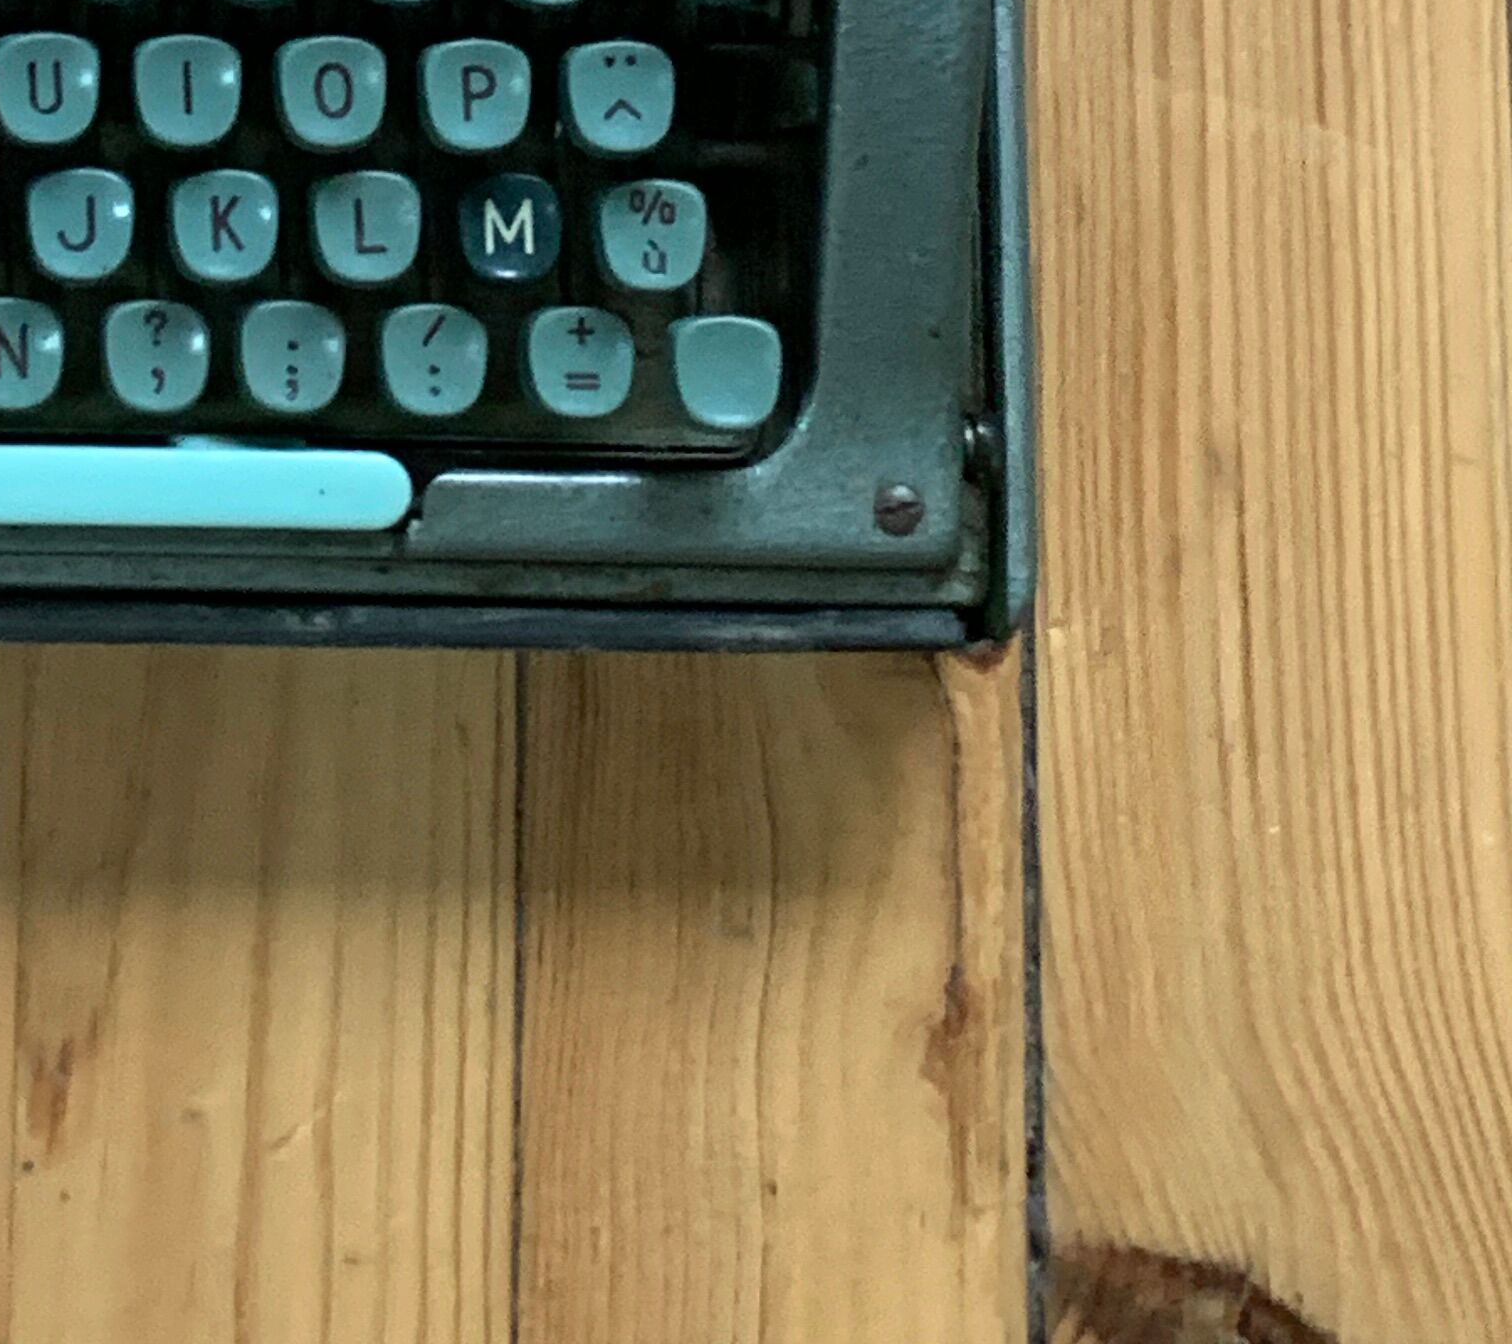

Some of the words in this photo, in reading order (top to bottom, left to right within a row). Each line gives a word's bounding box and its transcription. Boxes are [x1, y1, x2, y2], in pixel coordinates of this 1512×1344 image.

[26, 60, 63, 114] U
[183, 60, 192, 115] I
[313, 62, 353, 119] O
[461, 64, 497, 122] P
[629, 188, 676, 224] %
[57, 195, 95, 251] J
[210, 195, 245, 252] K
[354, 198, 388, 253] L
[486, 198, 535, 255] M
[642, 241, 667, 275] ù
[143, 309, 167, 345] ?
[422, 315, 446, 346] /
[567, 317, 595, 344] +
[564, 371, 600, 390] =
